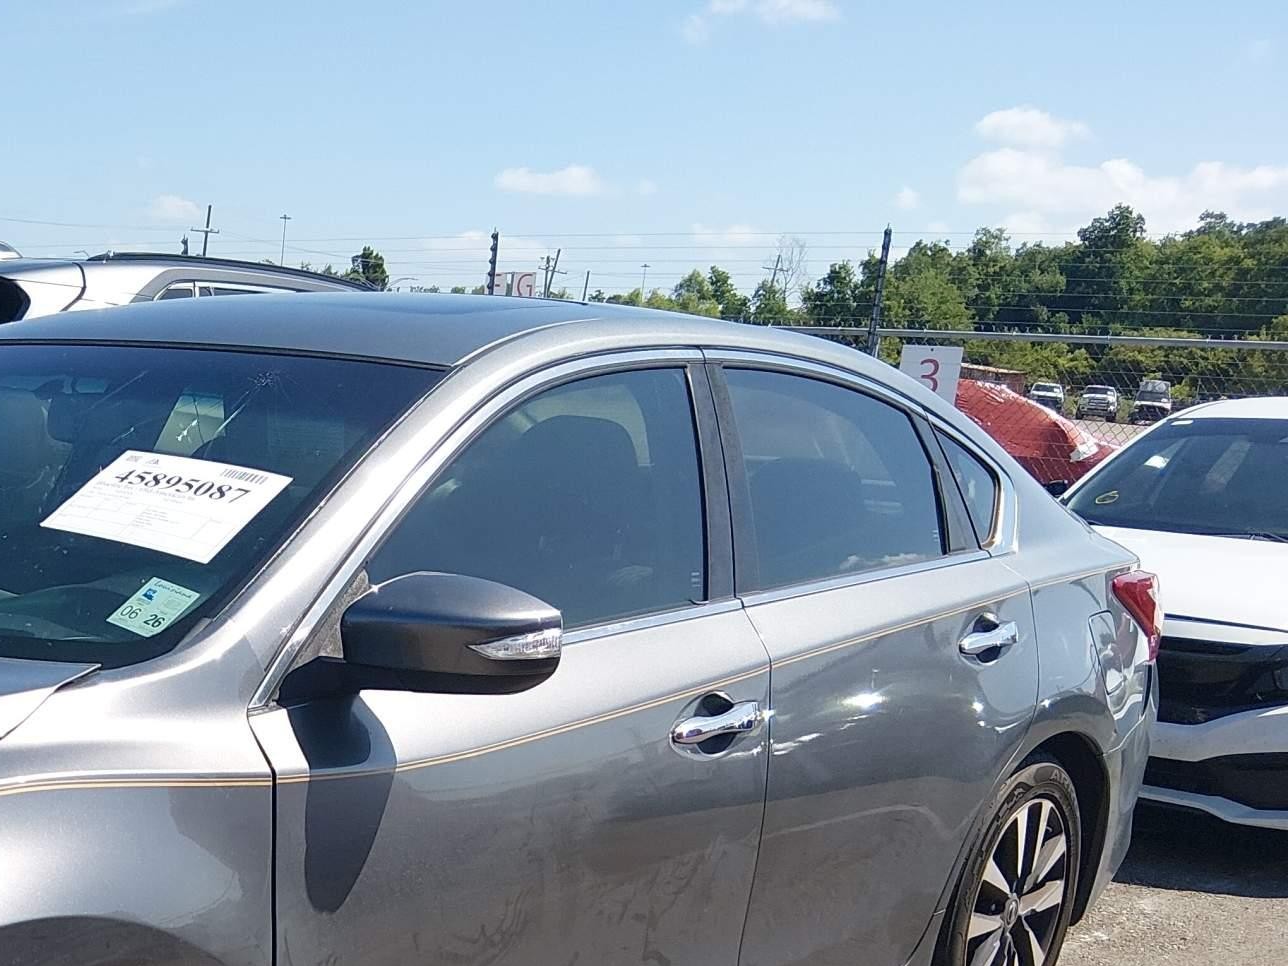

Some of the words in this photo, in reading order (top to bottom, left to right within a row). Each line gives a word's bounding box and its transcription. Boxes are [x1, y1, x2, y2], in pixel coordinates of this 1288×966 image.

[517, 273, 533, 297] G
[920, 358, 940, 393] 3
[114, 469, 252, 504] 45895087
[120, 605, 142, 620] 06
[143, 613, 166, 628] 26
